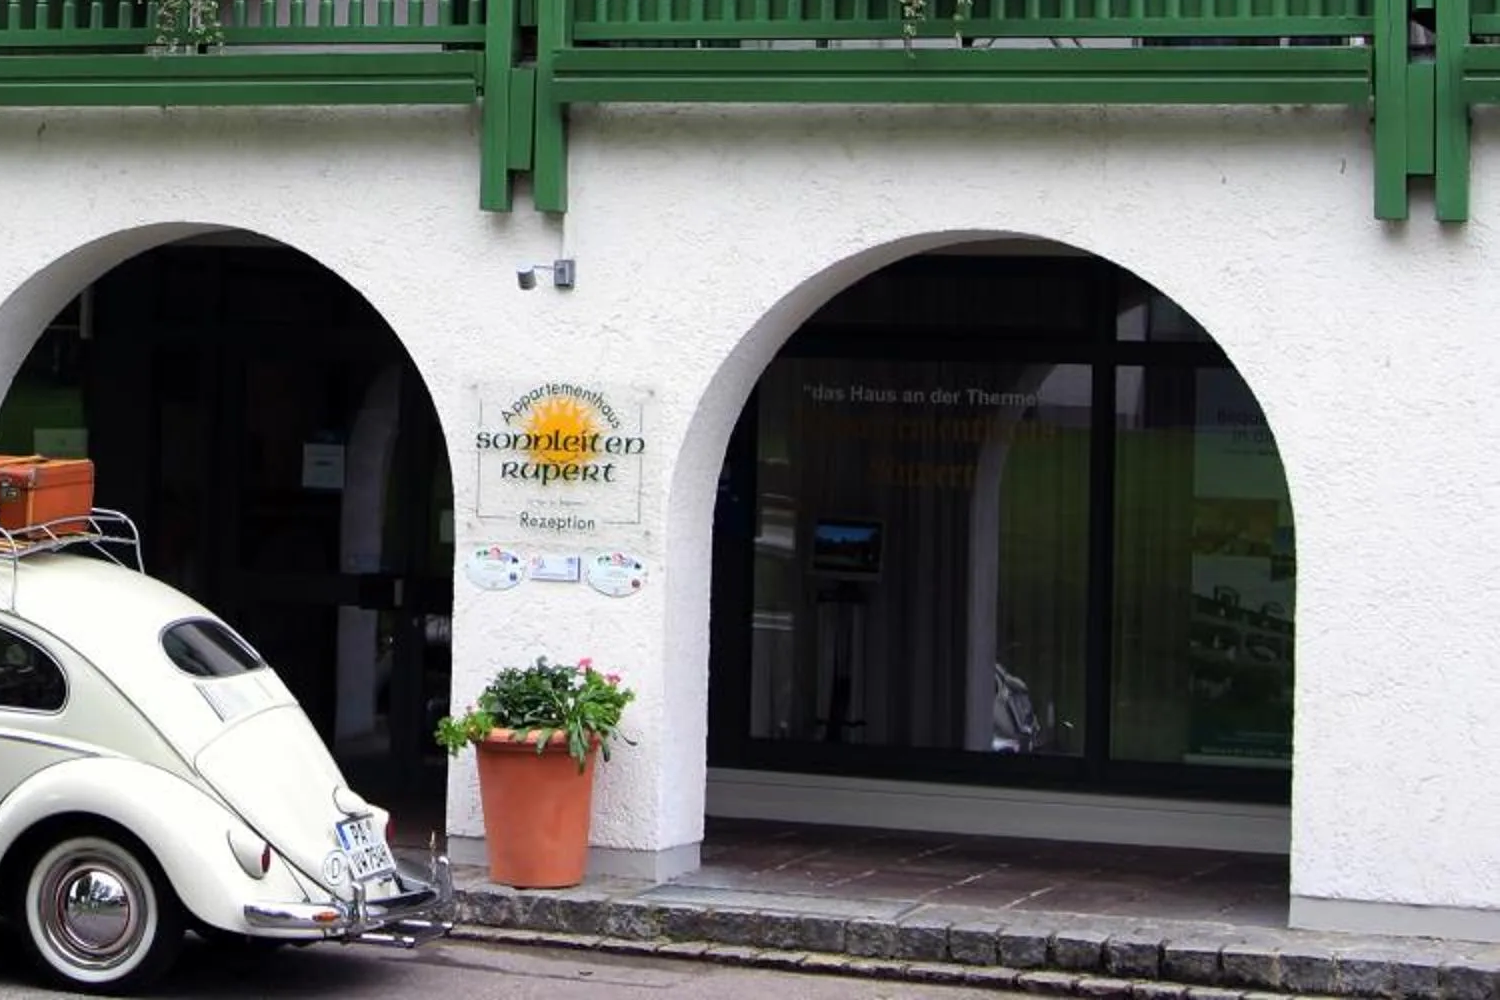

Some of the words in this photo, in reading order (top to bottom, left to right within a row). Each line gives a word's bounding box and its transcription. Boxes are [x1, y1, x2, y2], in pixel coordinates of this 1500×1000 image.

[501, 383, 621, 430] Appartementhaus
[850, 386, 897, 404] Haus
[903, 390, 925, 404] an
[930, 388, 960, 406] der
[520, 511, 596, 535] Rezeption
